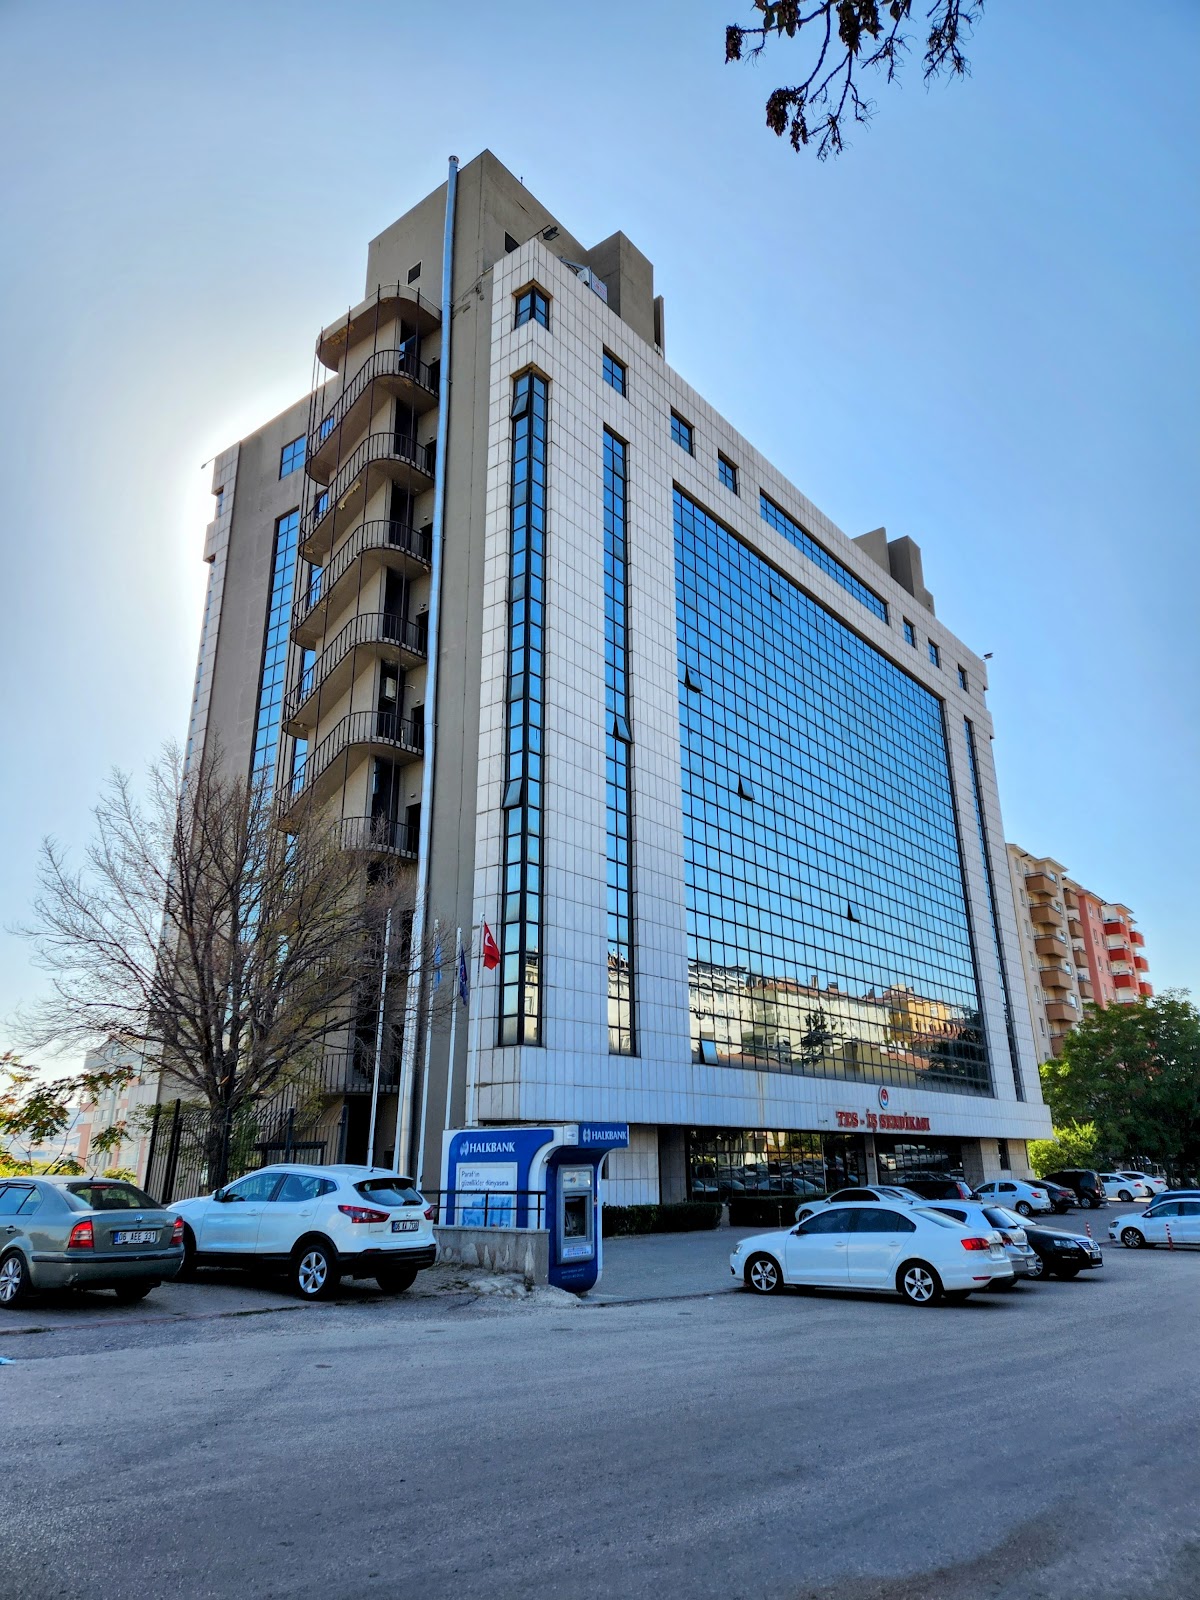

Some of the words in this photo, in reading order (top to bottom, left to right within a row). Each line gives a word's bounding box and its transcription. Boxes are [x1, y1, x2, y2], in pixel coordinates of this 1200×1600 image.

[836, 1111, 858, 1127] TES
[879, 1112, 930, 1130] SENDİKASI
[591, 1130, 627, 1140] HALKBANK
[469, 1142, 515, 1153] HALKBANK
[118, 1231, 127, 1241] 06
